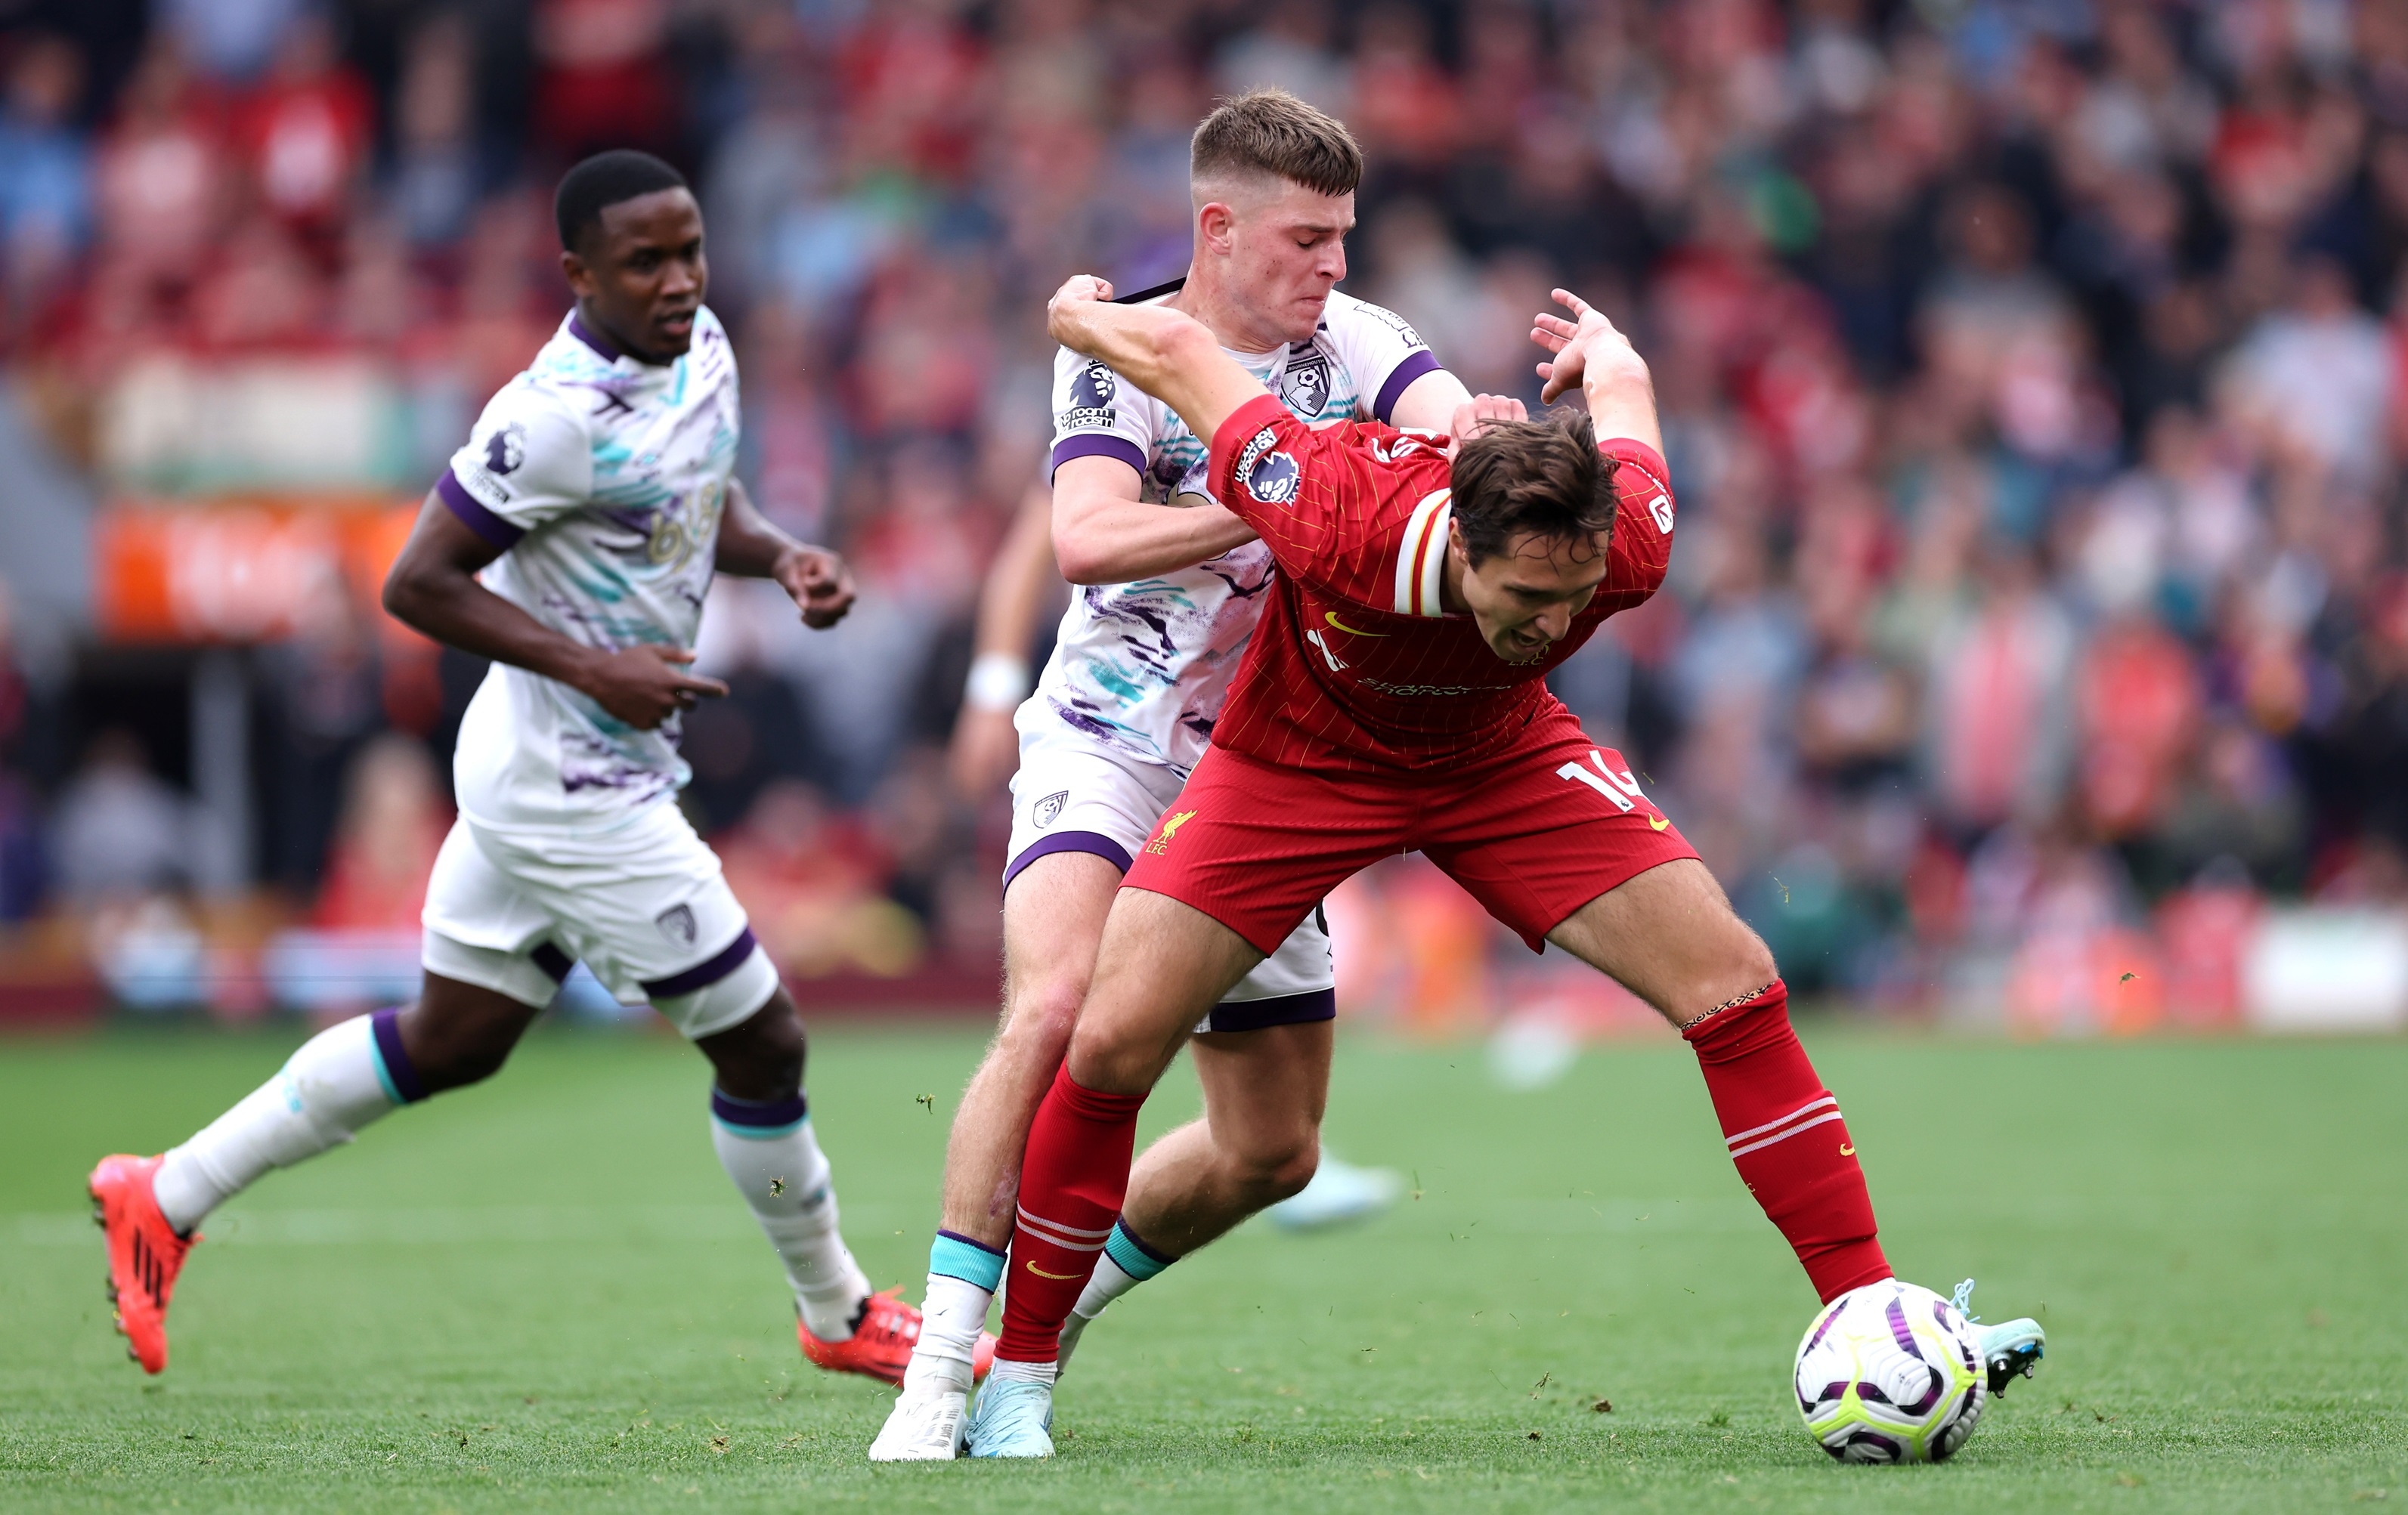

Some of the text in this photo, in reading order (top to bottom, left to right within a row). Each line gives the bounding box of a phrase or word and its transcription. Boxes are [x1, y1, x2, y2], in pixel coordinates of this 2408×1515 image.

[1288, 359, 1325, 371] BOURNEMOUTH
[1072, 407, 1109, 419] room
[1071, 416, 1114, 428] racism
